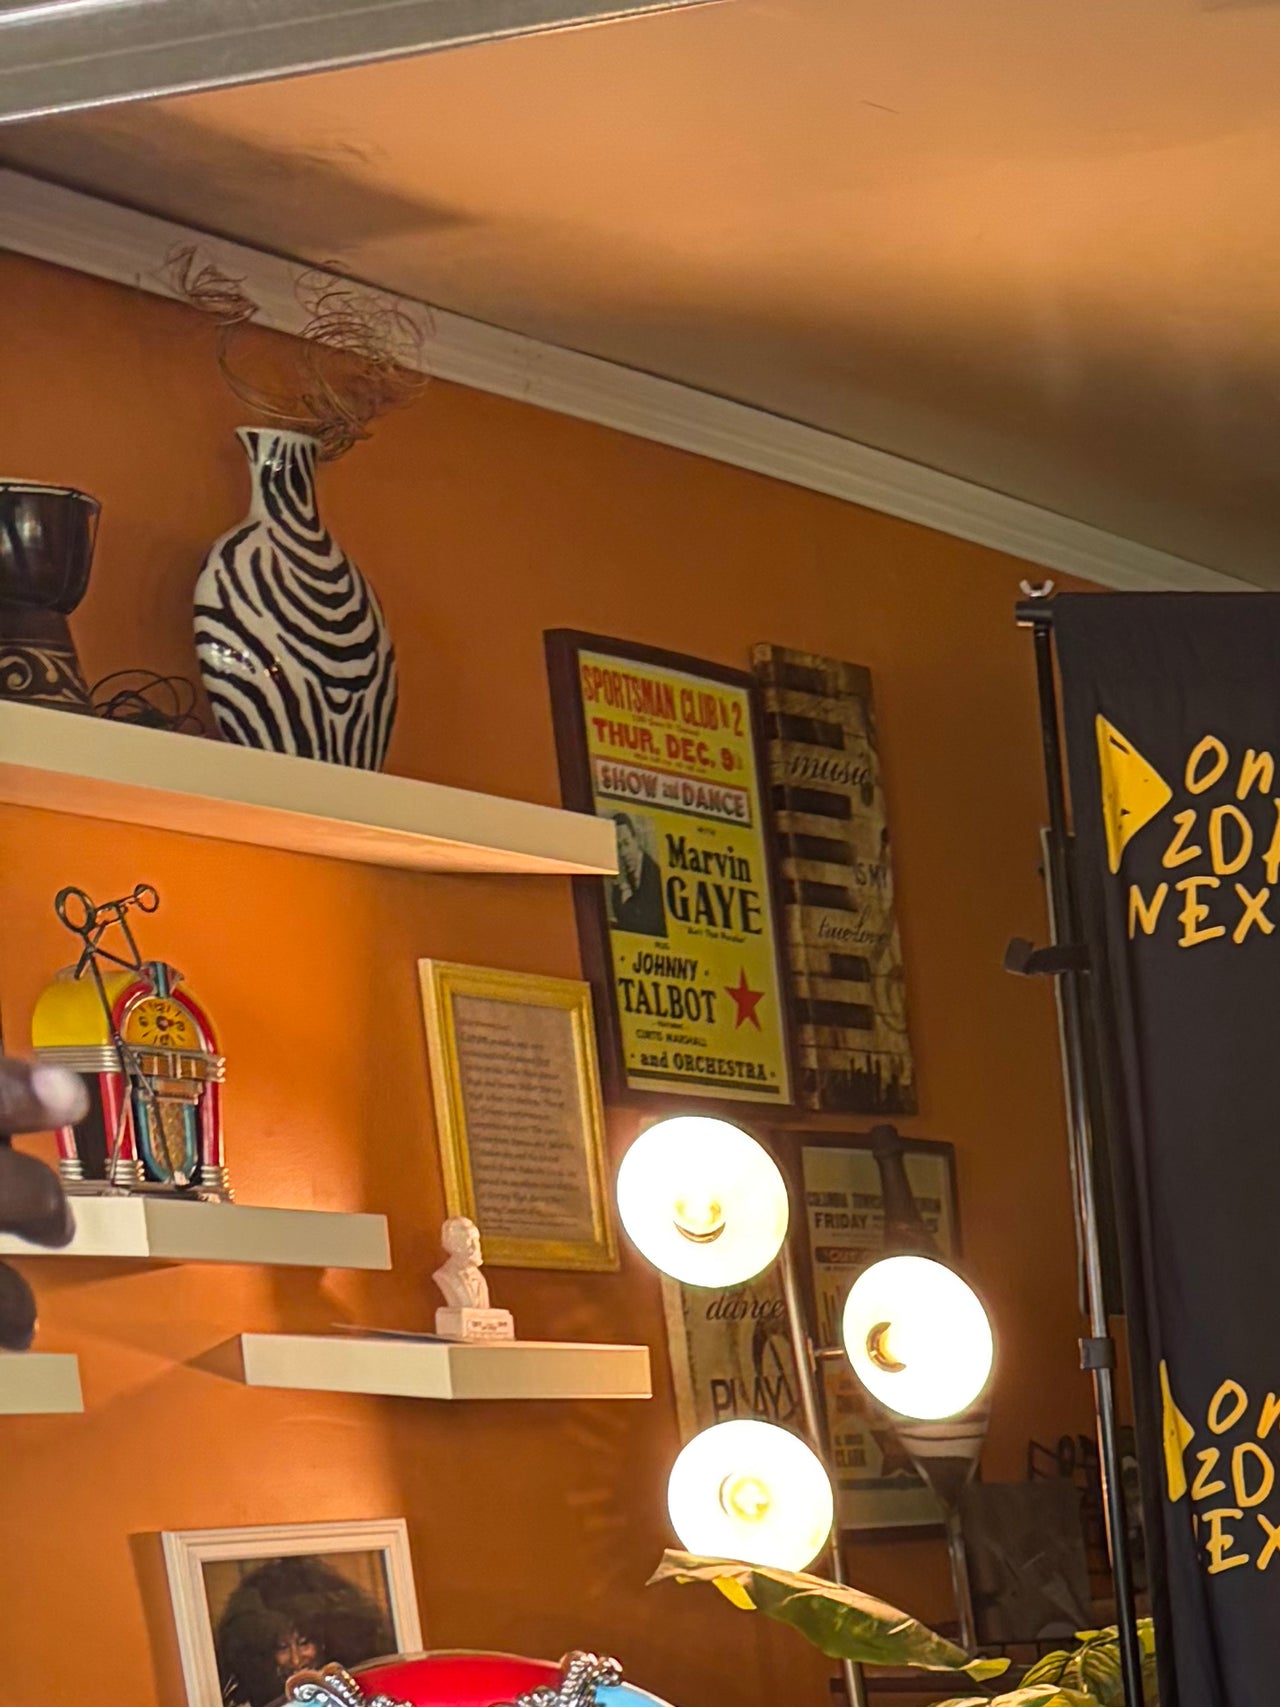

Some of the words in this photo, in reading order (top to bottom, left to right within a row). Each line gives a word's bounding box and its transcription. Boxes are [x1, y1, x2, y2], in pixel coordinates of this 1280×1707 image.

[582, 665, 676, 721] SPORTSMAN
[680, 688, 718, 732] CLUB
[592, 716, 661, 756] THUR.
[790, 751, 871, 788] music
[1185, 735, 1274, 800] On
[601, 765, 658, 799] SHOW
[682, 782, 745, 818] DANCE
[665, 834, 752, 883] Marvin
[666, 876, 763, 935] GAYE
[632, 951, 698, 981] JOHNNY
[618, 978, 717, 1025] TALBOT
[672, 1052, 767, 1081] ORCHESTRA
[814, 1211, 868, 1230] FRIDAY
[705, 1290, 785, 1322] dance
